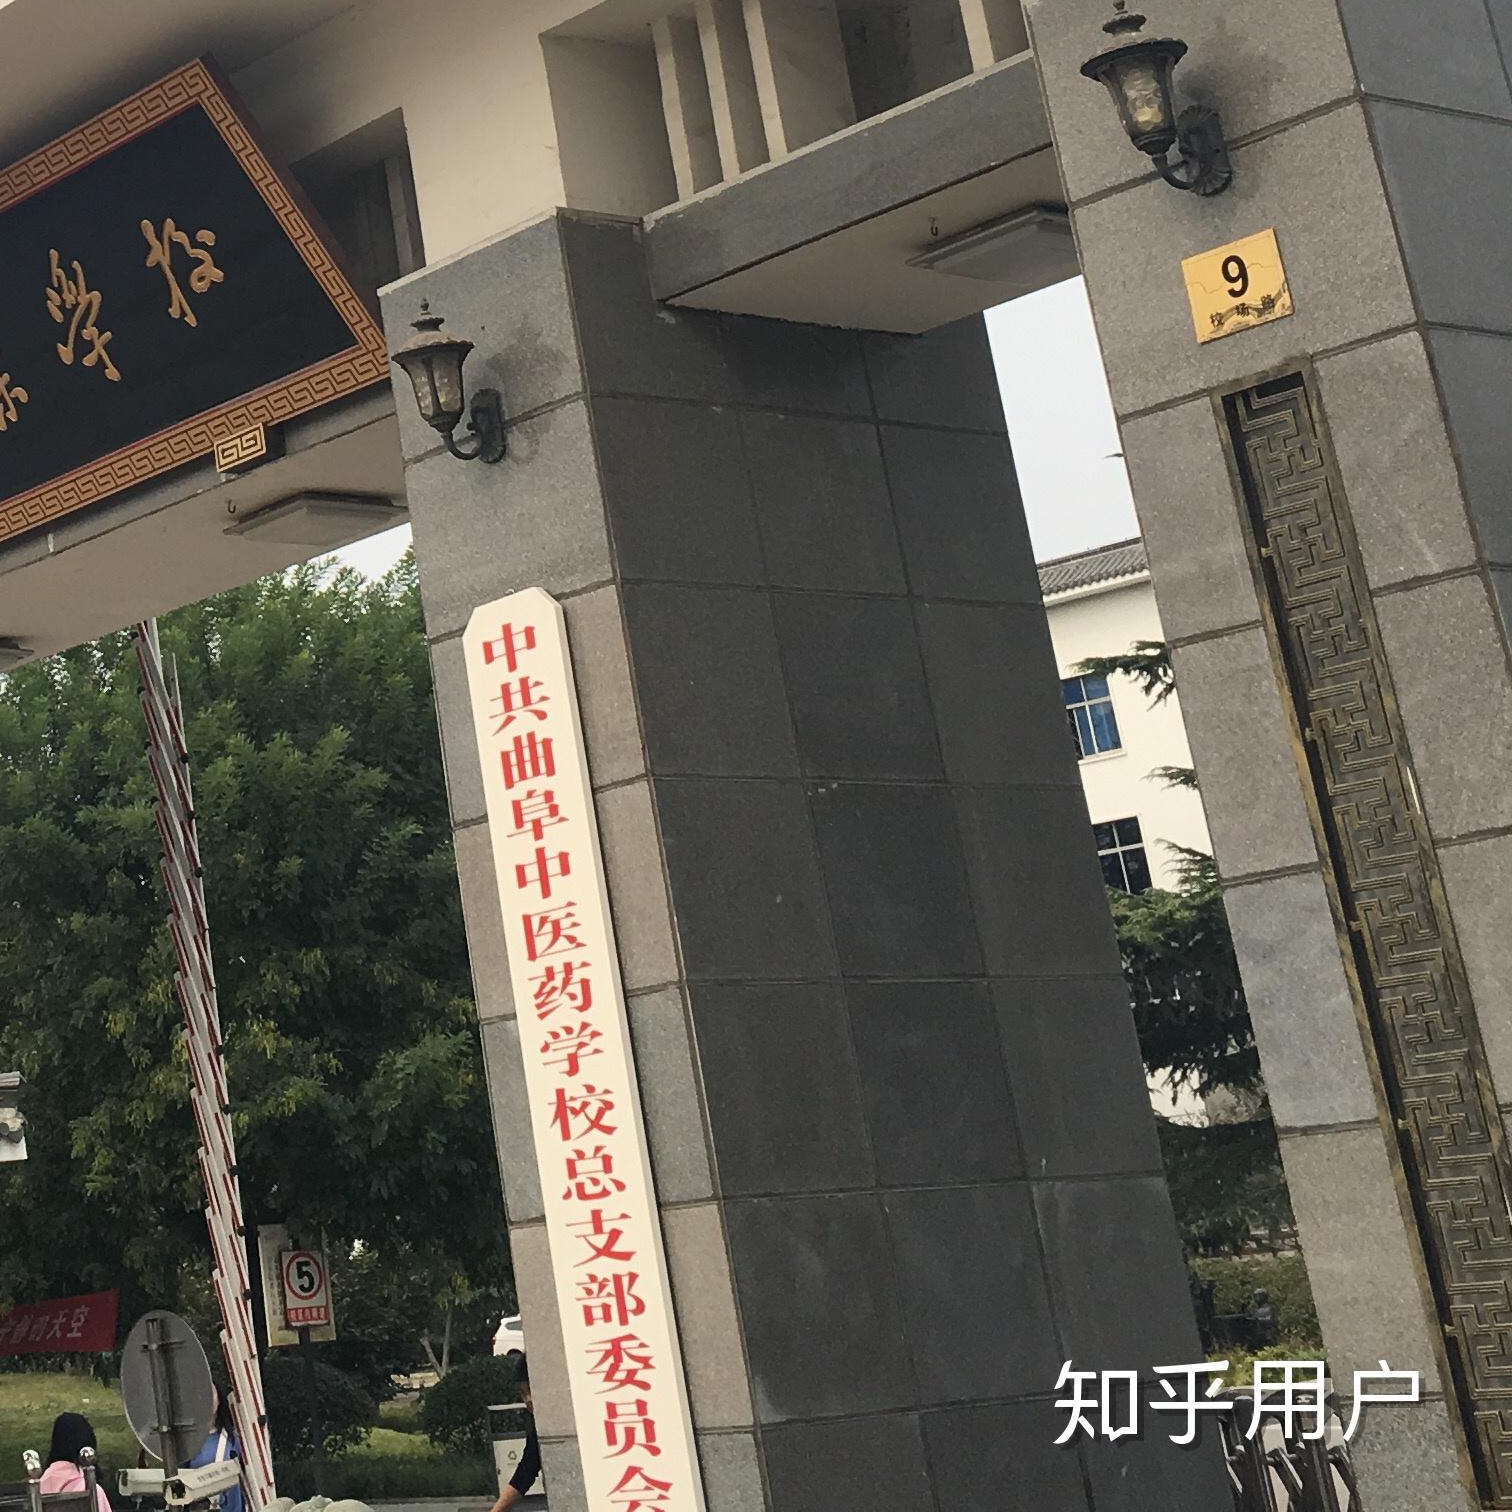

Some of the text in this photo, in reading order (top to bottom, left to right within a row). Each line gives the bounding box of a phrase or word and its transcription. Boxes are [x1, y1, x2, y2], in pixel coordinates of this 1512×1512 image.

[1221, 255, 1249, 298] 9
[482, 622, 673, 1512] 中共曲阜中医药学校总支部委员会
[296, 1260, 315, 1293] 5
